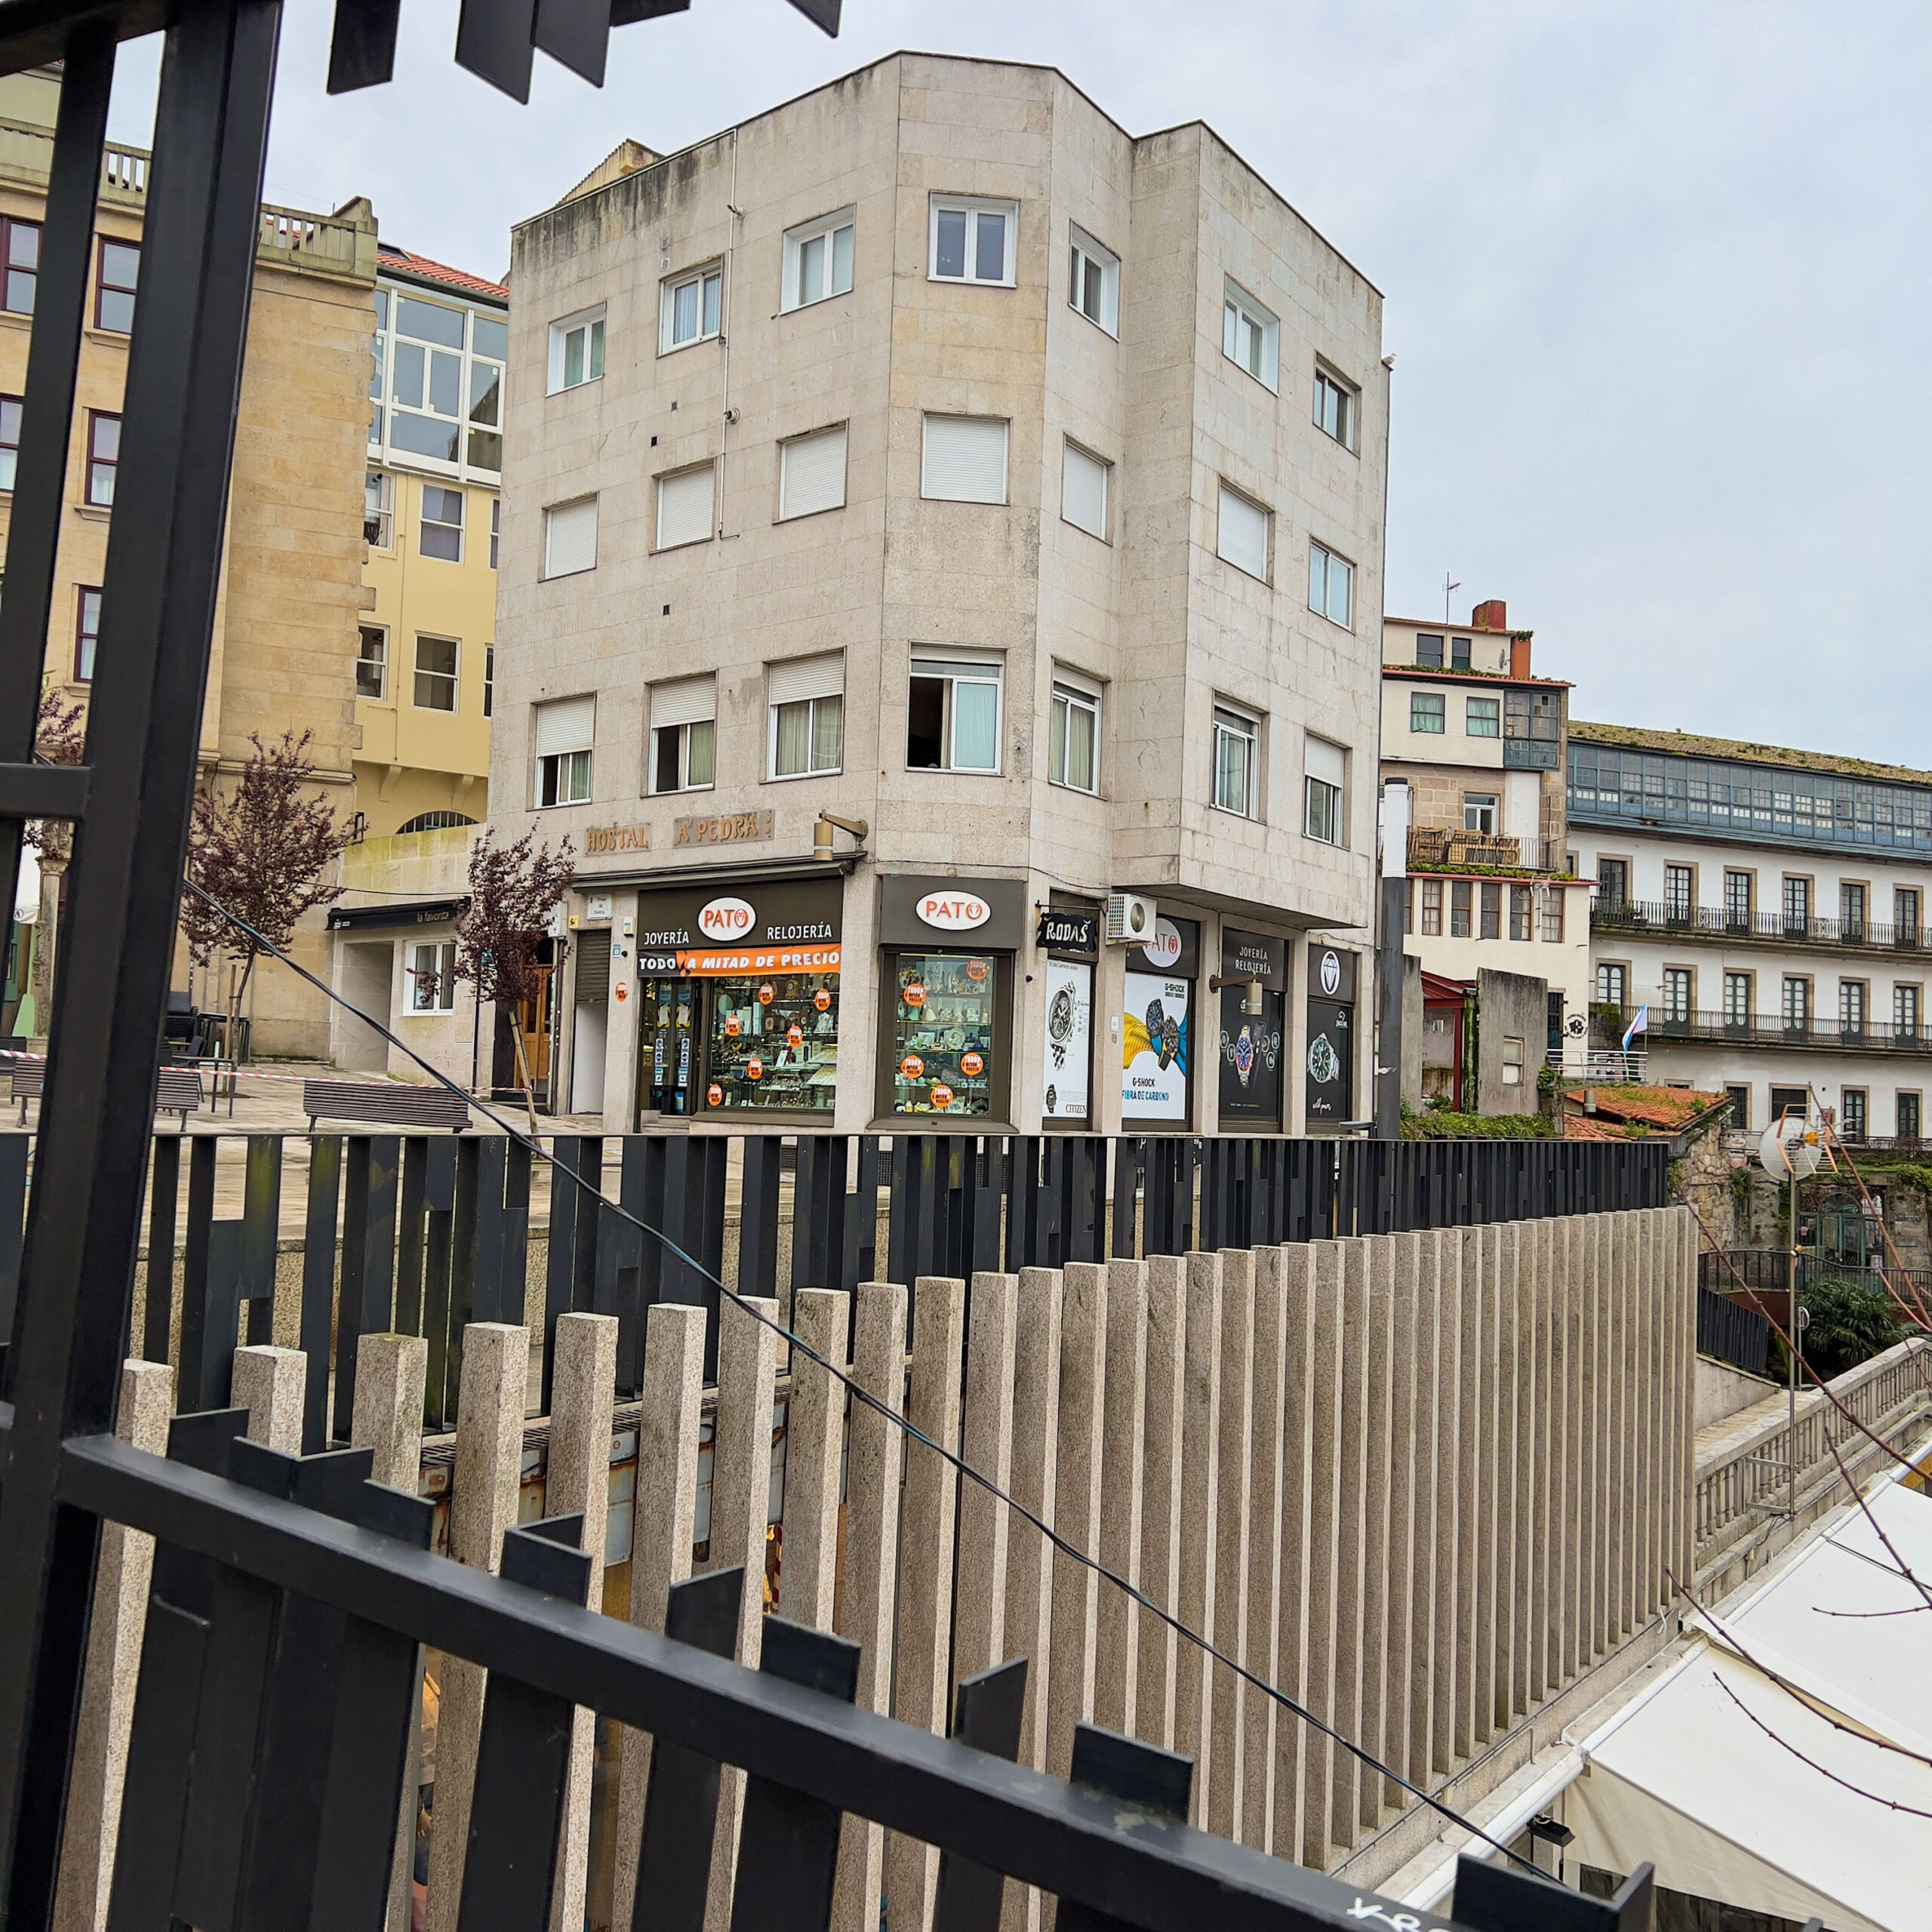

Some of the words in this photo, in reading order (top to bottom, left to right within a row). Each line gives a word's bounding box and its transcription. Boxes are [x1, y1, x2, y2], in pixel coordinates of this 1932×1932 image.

[587, 827, 649, 852] HOSTAL
[704, 909, 749, 928] PATO
[926, 900, 983, 920] PATO
[644, 928, 690, 945] JOYERÍA
[767, 921, 832, 940] RELOJERÍA
[1046, 920, 1088, 943] RODAS
[1146, 933, 1177, 955] ATO
[639, 958, 676, 970] TODO
[687, 958, 697, 969] A
[702, 956, 749, 969] MITAD
[755, 955, 775, 968] DE
[781, 952, 839, 967] PRECIO
[1239, 946, 1268, 961] JOYERÍA
[1235, 959, 1271, 975] RELOJERÍA
[1132, 1078, 1155, 1088] G-SHOCK
[1122, 1090, 1137, 1100] FIBRA
[1137, 1091, 1144, 1100] DE
[1066, 1104, 1087, 1113] CITIZEN
